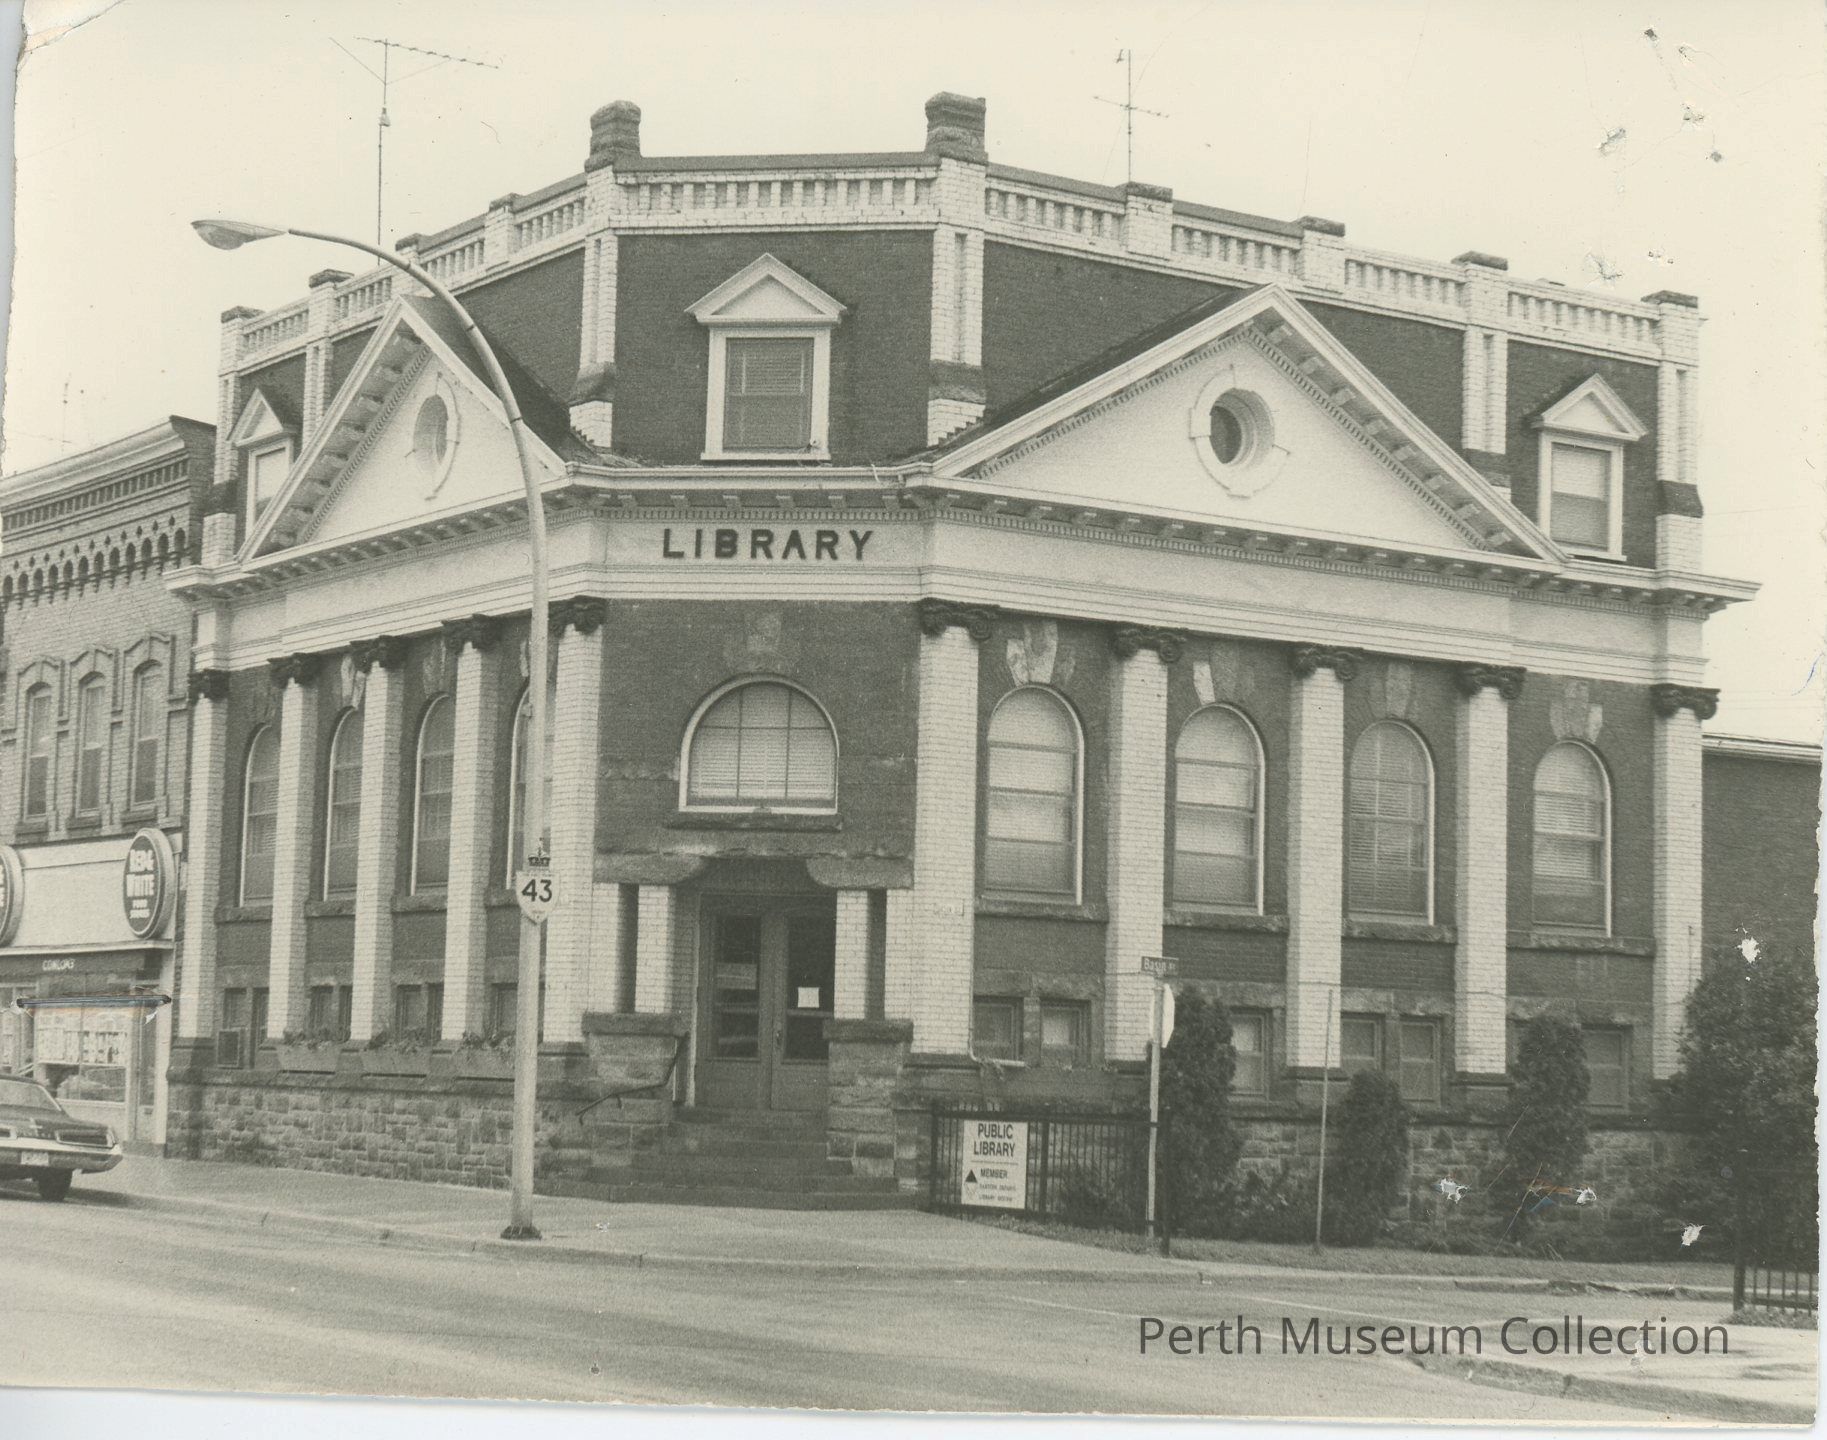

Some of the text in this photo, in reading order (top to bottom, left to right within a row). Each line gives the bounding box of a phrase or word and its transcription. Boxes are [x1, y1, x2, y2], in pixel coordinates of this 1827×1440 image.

[663, 528, 873, 560] LIBRARY
[521, 878, 553, 903] 43
[978, 1123, 1013, 1139] PUBLIC
[973, 1141, 1015, 1157] LIBRARY
[980, 1168, 1008, 1179] MEMBER
